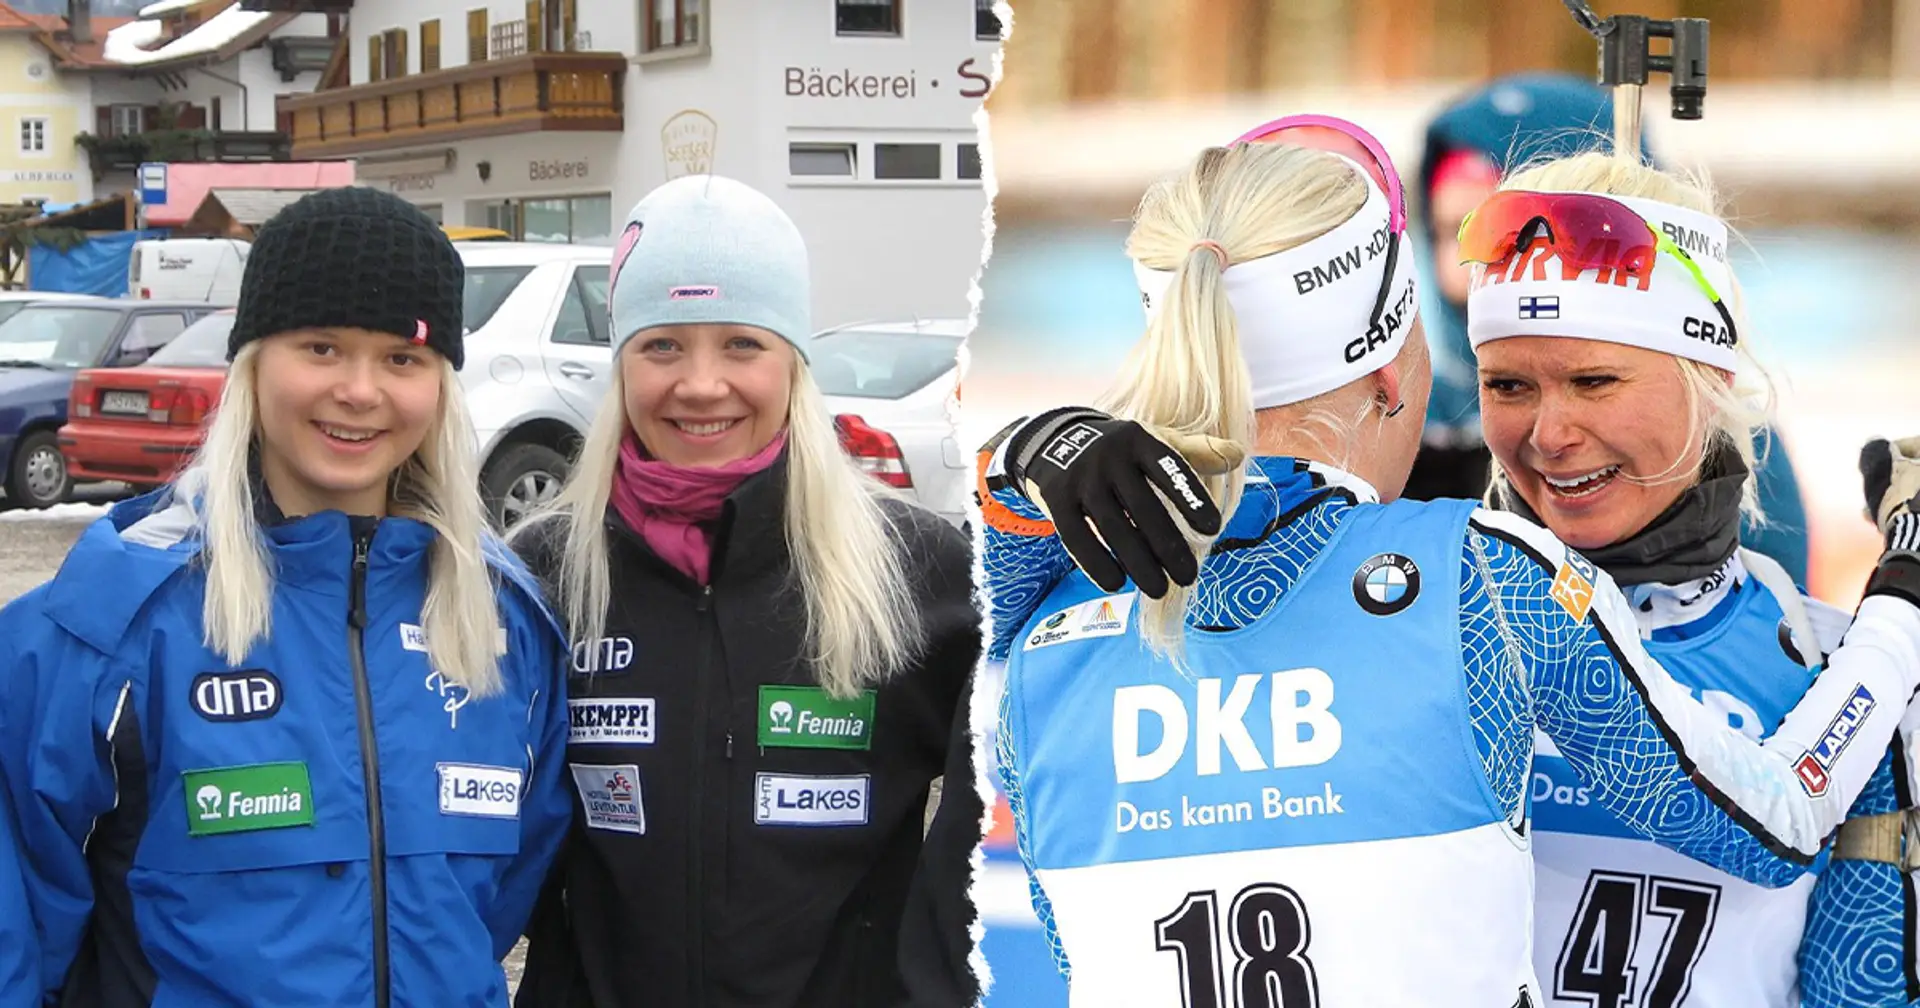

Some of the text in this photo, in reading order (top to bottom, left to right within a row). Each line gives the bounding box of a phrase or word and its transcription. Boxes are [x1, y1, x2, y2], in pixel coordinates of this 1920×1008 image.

[785, 67, 916, 97] Bäckerei
[529, 156, 589, 181] Bäckerei
[1662, 221, 1712, 255] BMW
[1293, 246, 1362, 295] BMW
[1682, 316, 1734, 349] CRA
[1362, 554, 1417, 576] BMW
[573, 637, 634, 673] dna
[196, 676, 276, 716] dna
[571, 704, 649, 728] KEMPPI
[797, 710, 864, 737] Fennia
[1113, 667, 1341, 784] DKB
[1815, 696, 1872, 767] LAPUA
[228, 787, 301, 819] Fennia
[454, 777, 517, 803] Lakes
[777, 788, 861, 810] Lakes
[1532, 773, 1590, 806] Das
[1116, 783, 1344, 834] Das kann Bank
[1154, 880, 1320, 1008] 18
[1554, 869, 1722, 1008] 47
